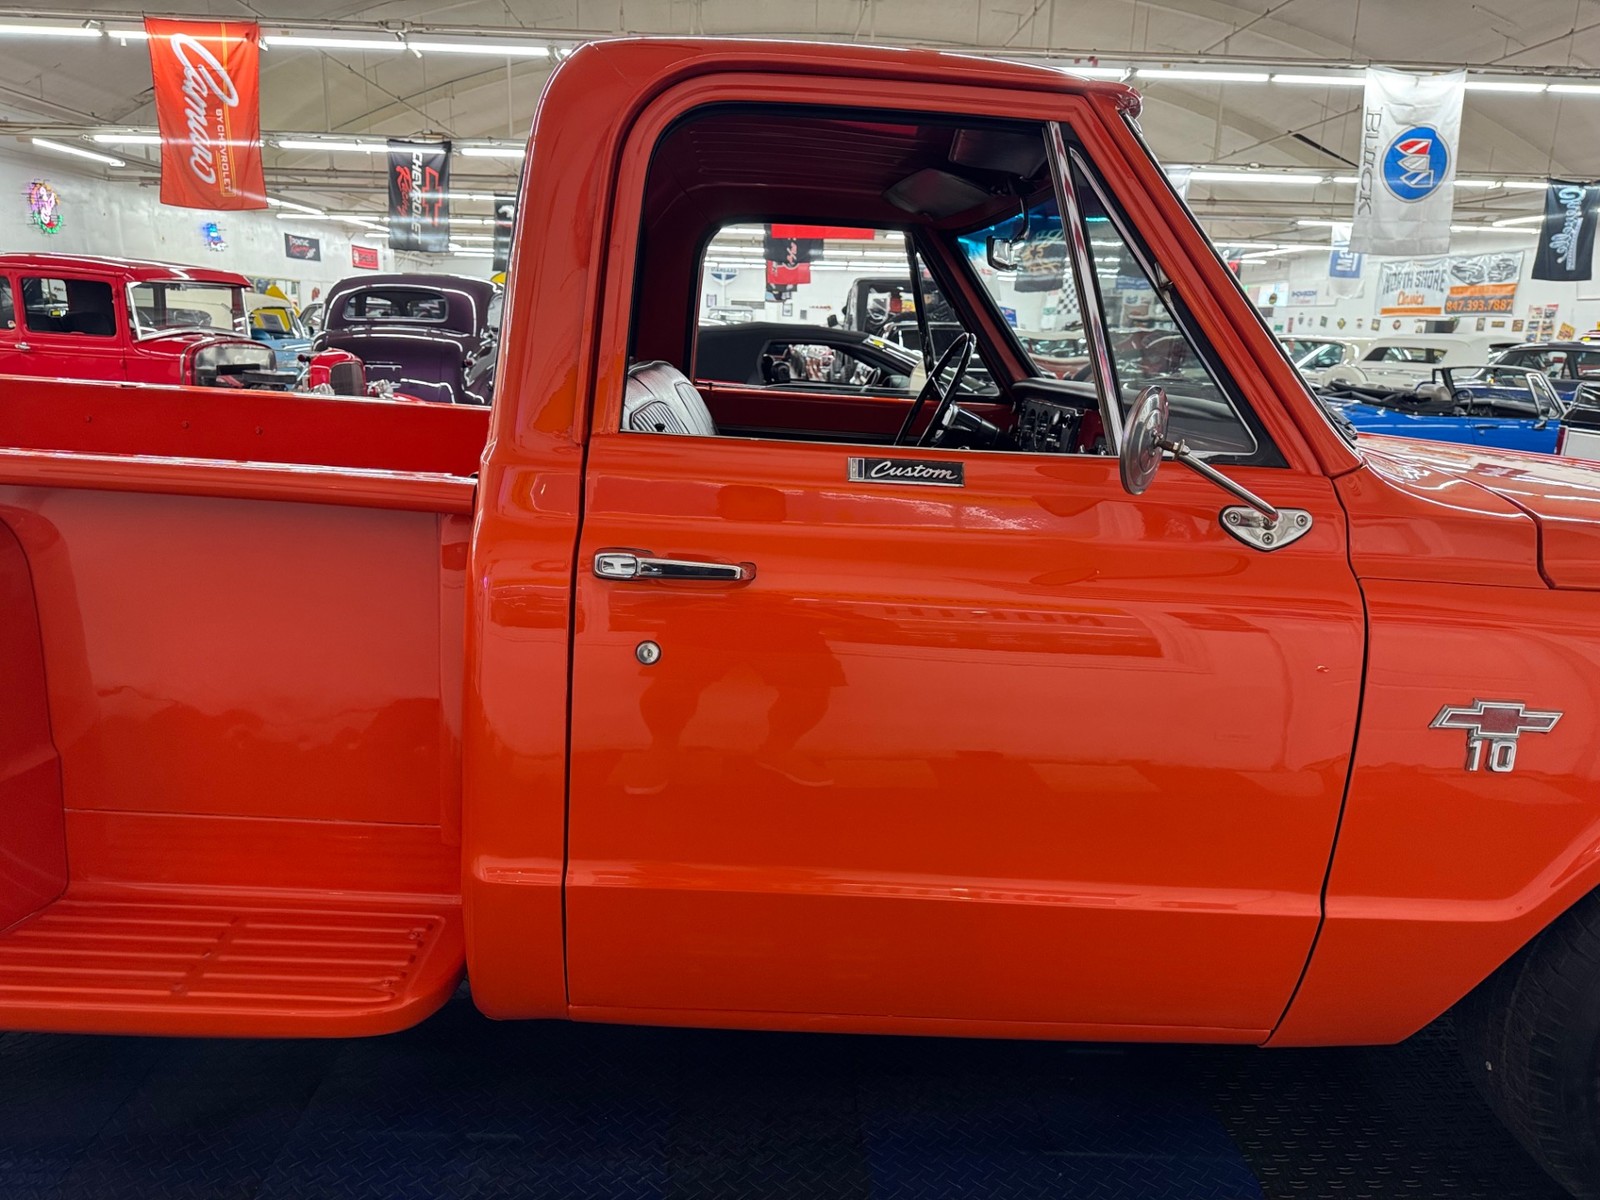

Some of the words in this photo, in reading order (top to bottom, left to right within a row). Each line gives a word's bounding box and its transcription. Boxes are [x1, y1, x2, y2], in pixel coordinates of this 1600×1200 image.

[170, 33, 239, 184] Camaro
[215, 108, 224, 124] BY
[217, 125, 231, 191] CHEVROLET
[1358, 106, 1382, 215] BUICK
[411, 151, 422, 244] CHEVROLET
[1382, 271, 1414, 295] NORTH
[1415, 268, 1448, 292] SHORE
[870, 460, 958, 480] Custom
[1466, 739, 1517, 773] 10
